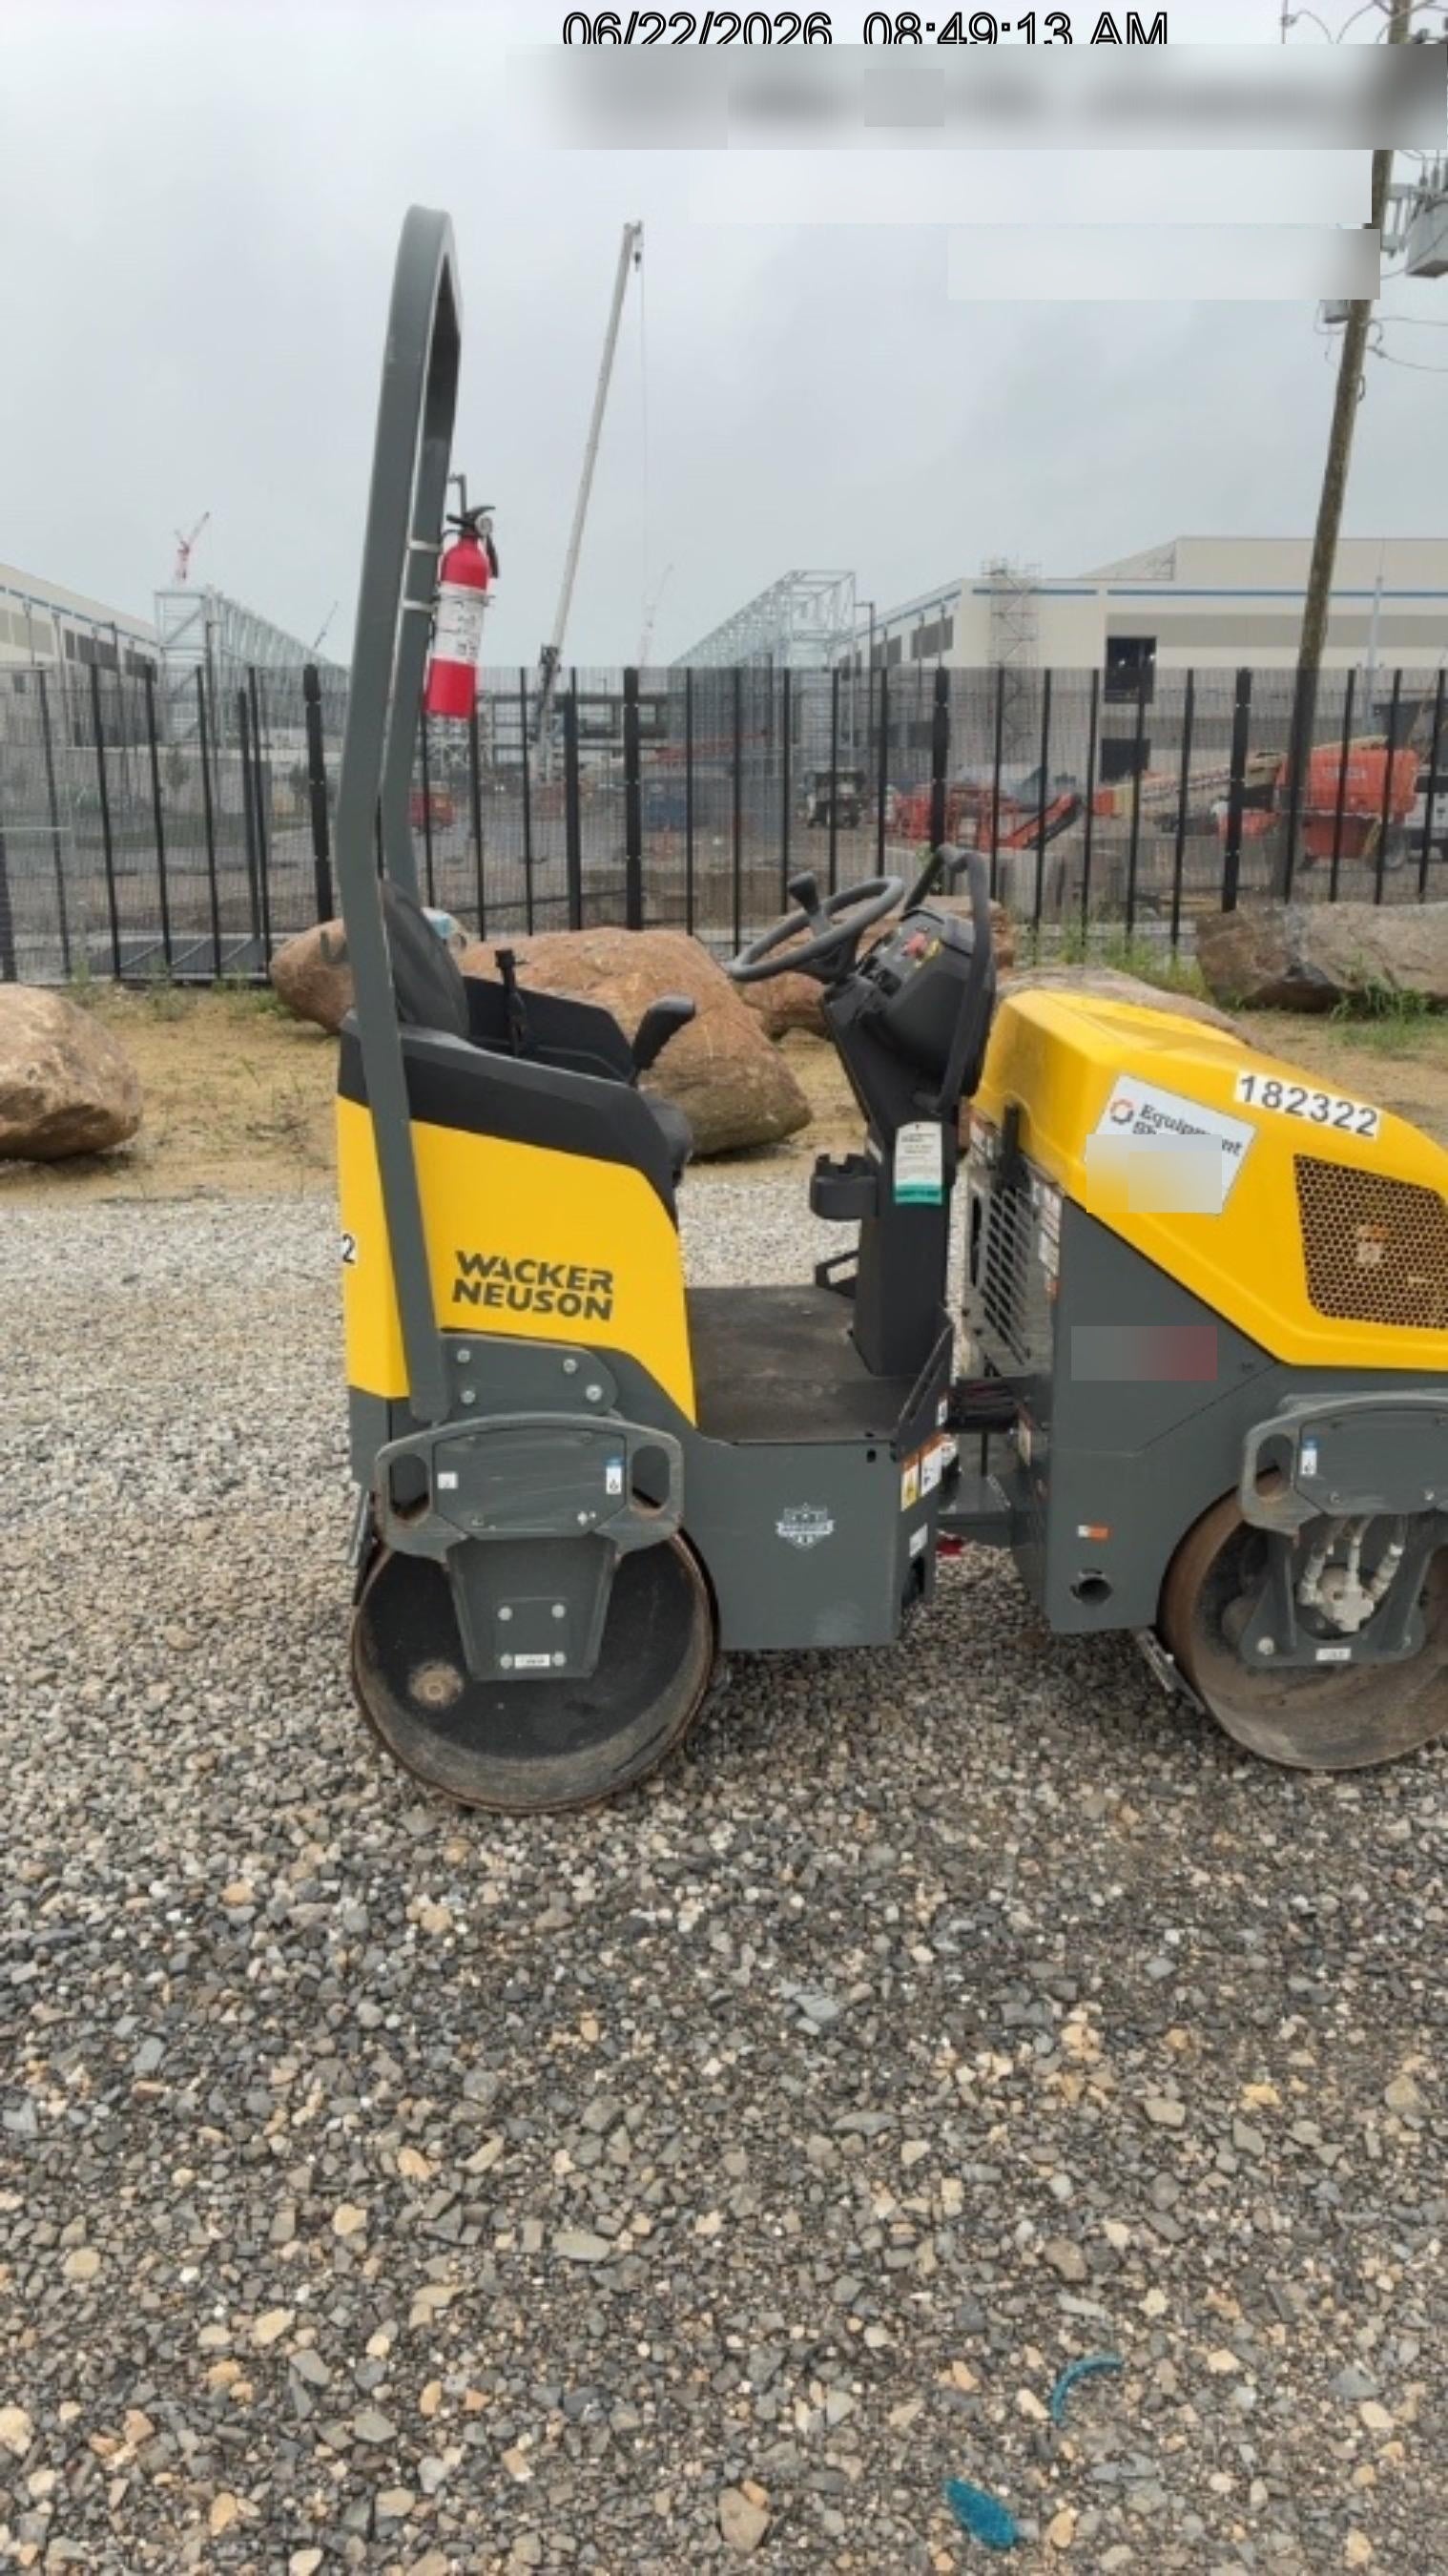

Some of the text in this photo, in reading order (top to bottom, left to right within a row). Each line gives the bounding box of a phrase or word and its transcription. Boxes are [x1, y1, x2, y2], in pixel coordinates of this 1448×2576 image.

[1241, 1075, 1377, 1136] 182322
[1139, 1104, 1242, 1156] Equipnt
[455, 1250, 613, 1294] WACKER
[452, 1278, 612, 1320] NEUSON
